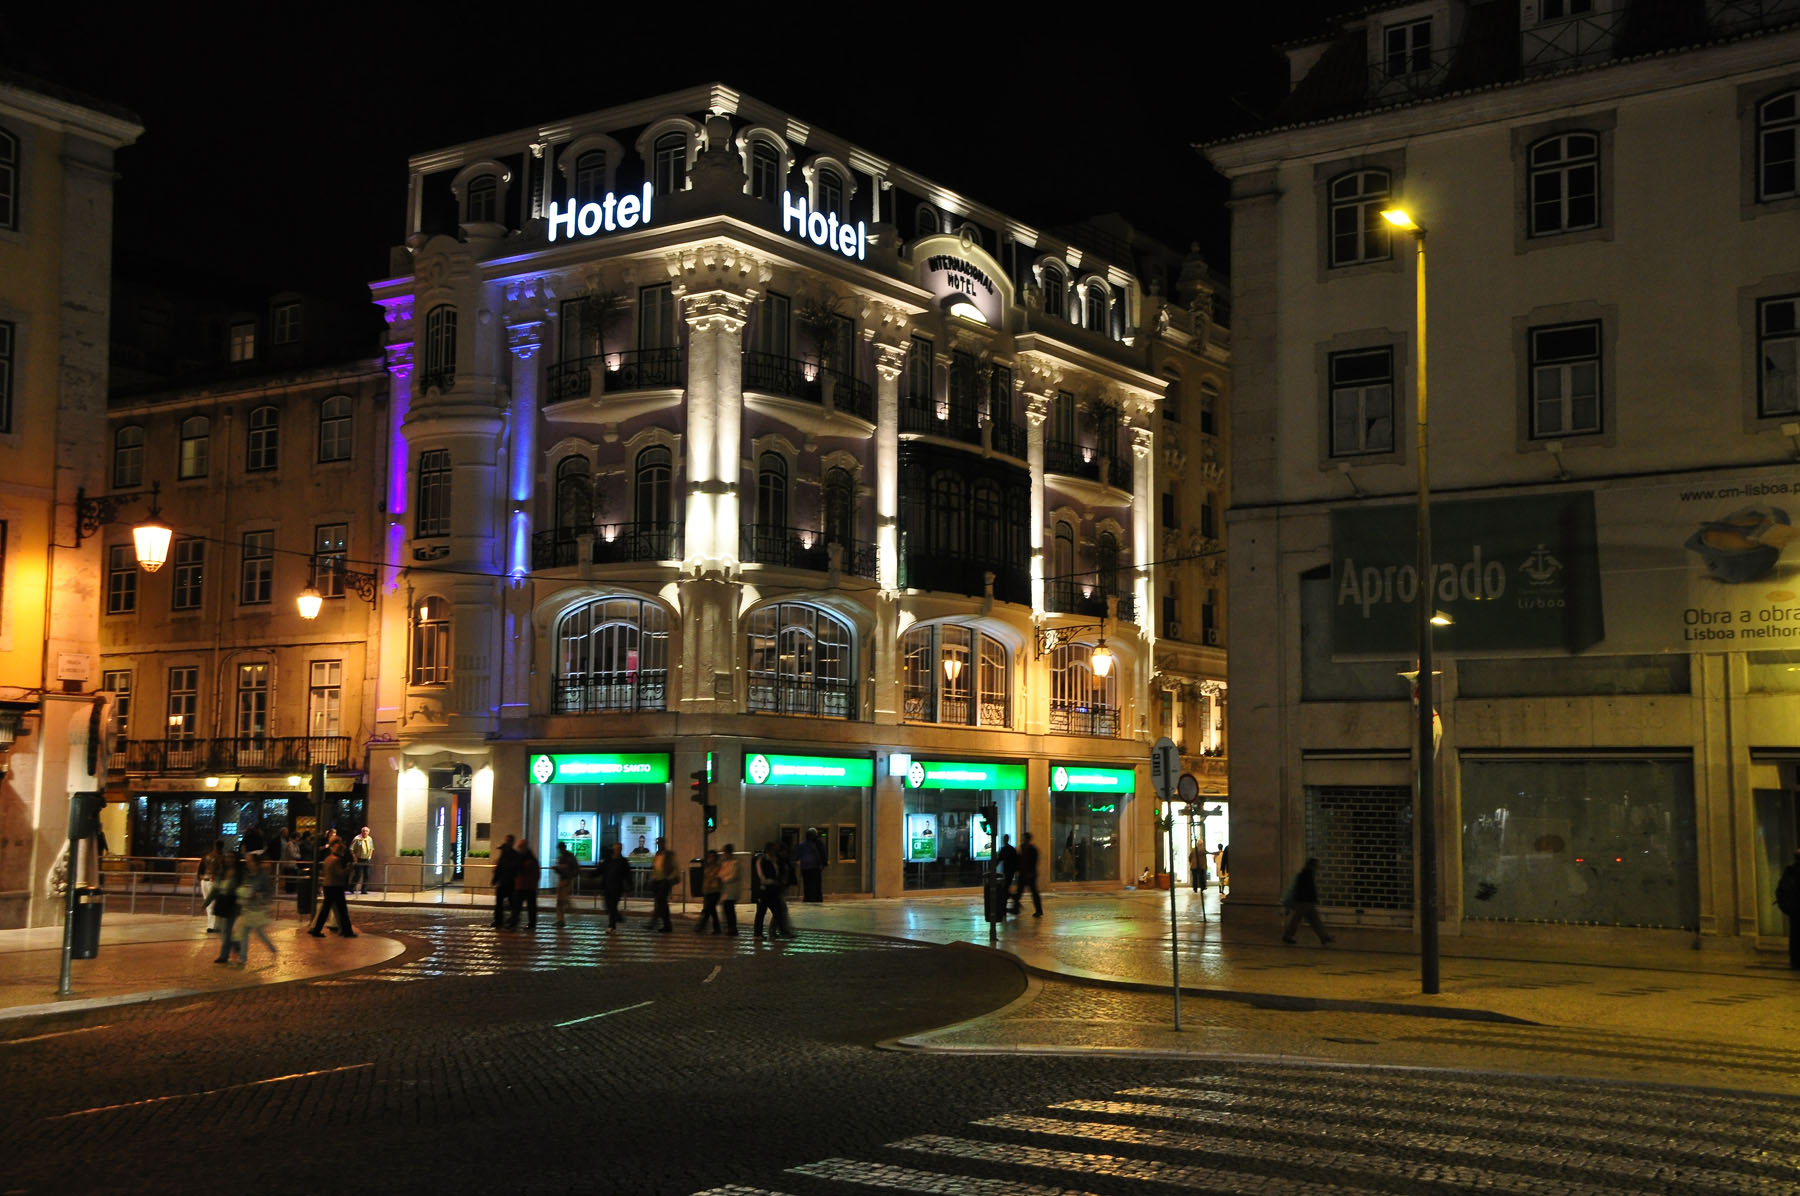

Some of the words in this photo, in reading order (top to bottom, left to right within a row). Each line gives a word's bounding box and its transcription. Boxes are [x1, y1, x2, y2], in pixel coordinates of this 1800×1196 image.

[548, 181, 652, 242] Hotel
[783, 190, 866, 261] Hotel
[947, 271, 977, 297] HOTEL
[1683, 608, 1732, 625] Obra
[1740, 610, 1752, 623] a
[1684, 627, 1735, 640] Lisboa
[1741, 625, 1800, 639] melhor
